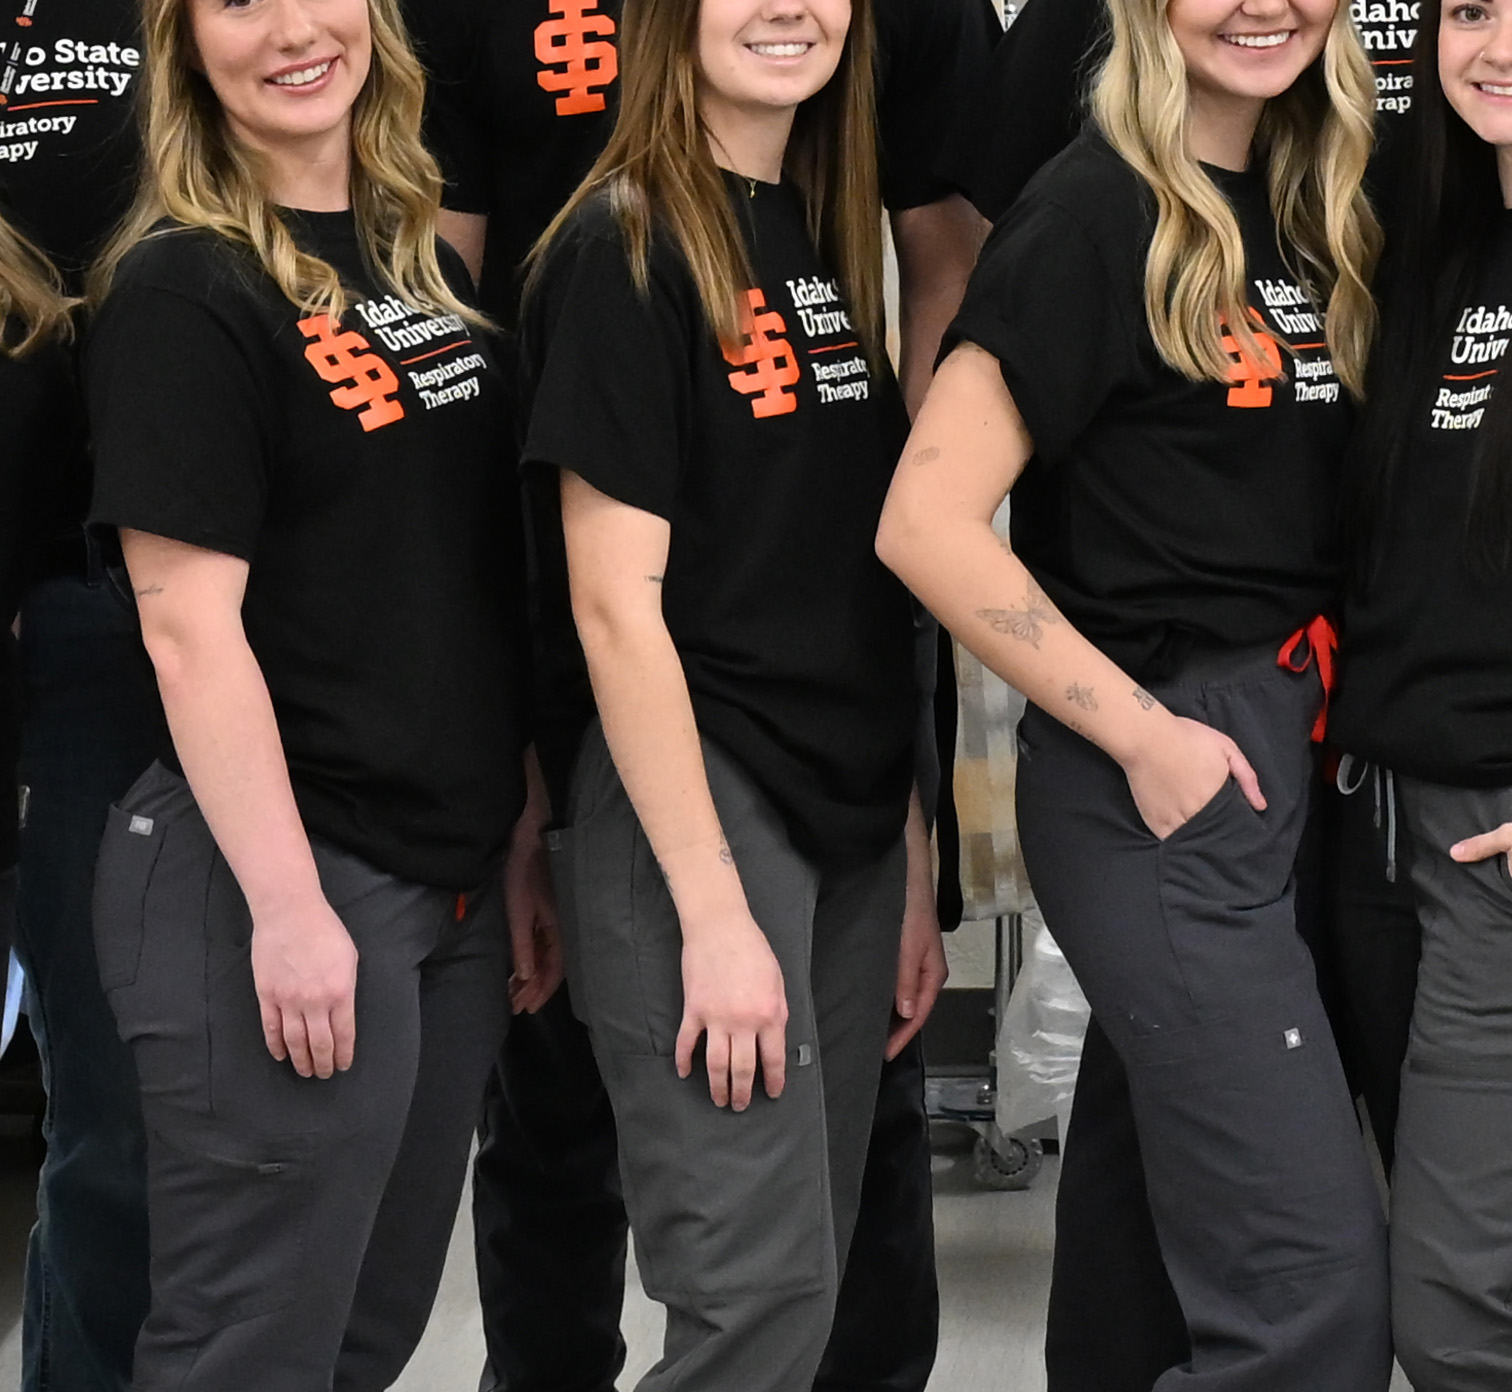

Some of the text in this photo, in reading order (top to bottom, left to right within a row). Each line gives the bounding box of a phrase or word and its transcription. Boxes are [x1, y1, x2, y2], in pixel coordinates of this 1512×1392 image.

[54, 38, 141, 66] State
[355, 294, 419, 329] Idah
[797, 306, 852, 337] Unive
[408, 353, 487, 390] Respiratory
[1294, 356, 1333, 381] Respira
[419, 376, 480, 410] Therapy
[1295, 381, 1340, 403] Therapy
[1435, 384, 1491, 411] Respirat
